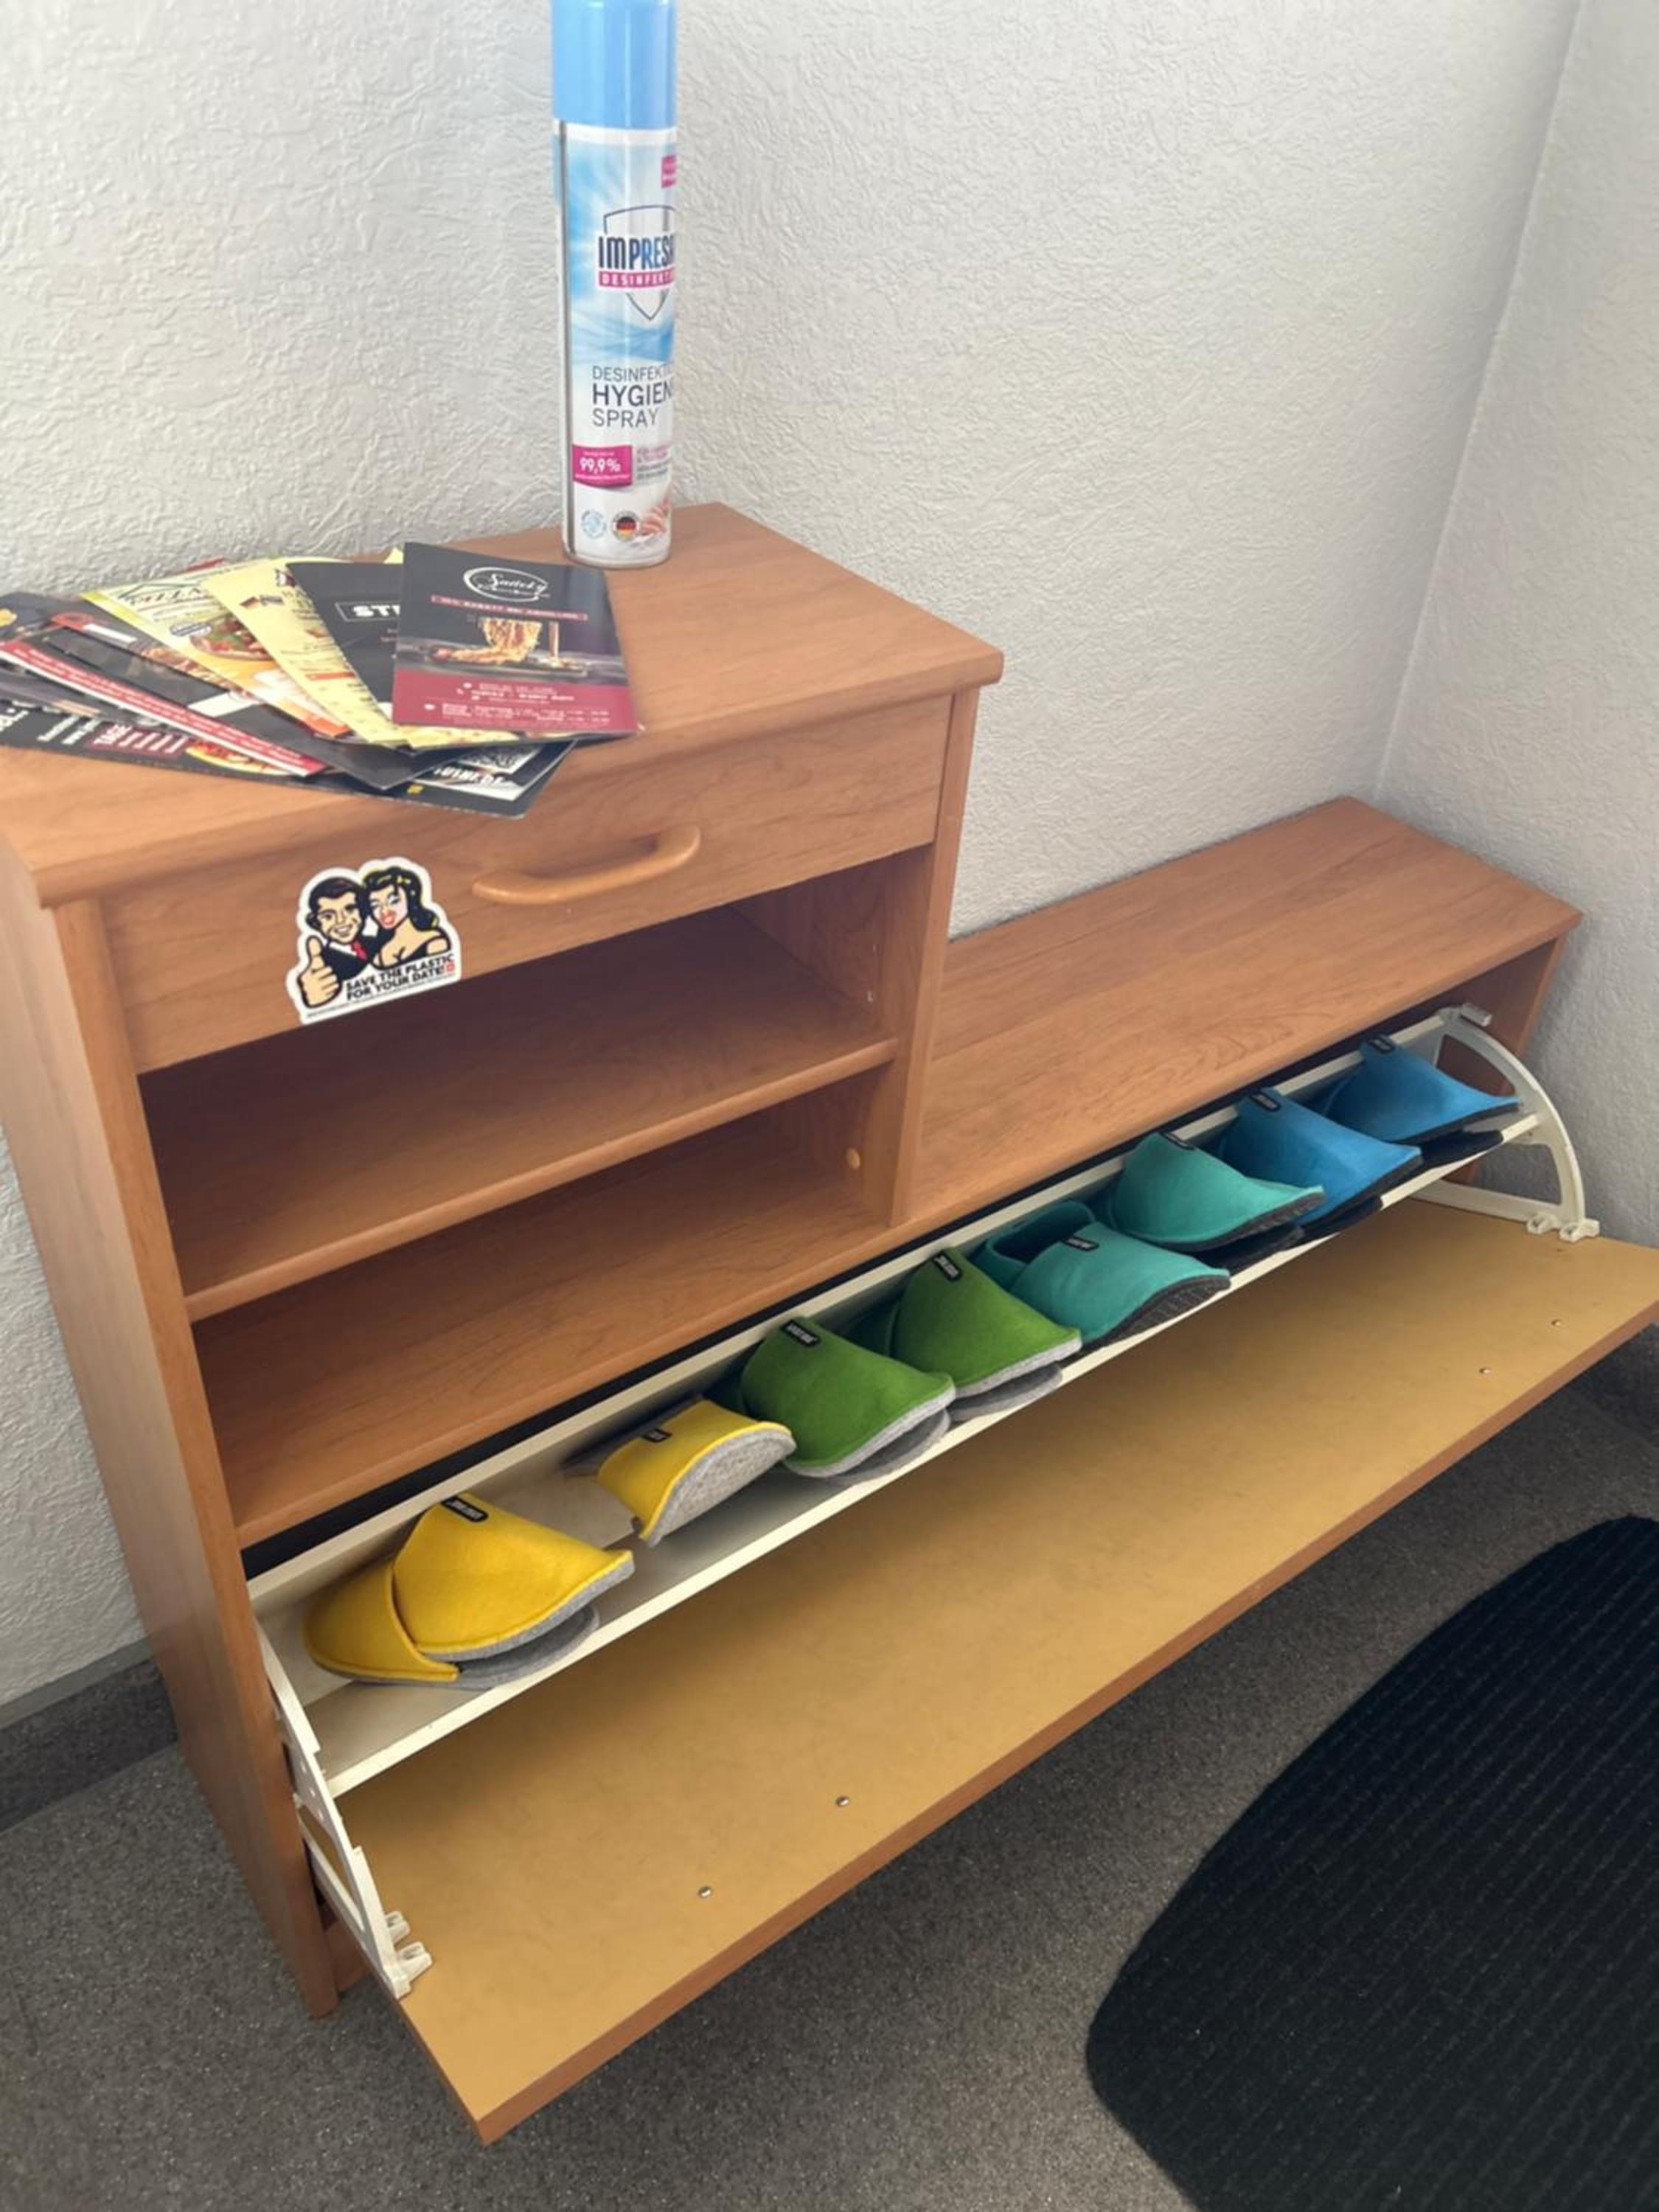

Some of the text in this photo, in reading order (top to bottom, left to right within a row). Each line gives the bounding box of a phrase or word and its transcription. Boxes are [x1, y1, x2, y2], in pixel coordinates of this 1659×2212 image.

[592, 408, 658, 428] SPRAY
[347, 975, 375, 990] SAVE
[380, 968, 402, 981] THE
[406, 953, 453, 973] PLASTIC
[347, 986, 371, 1000] FOR
[376, 976, 410, 992] YOUR
